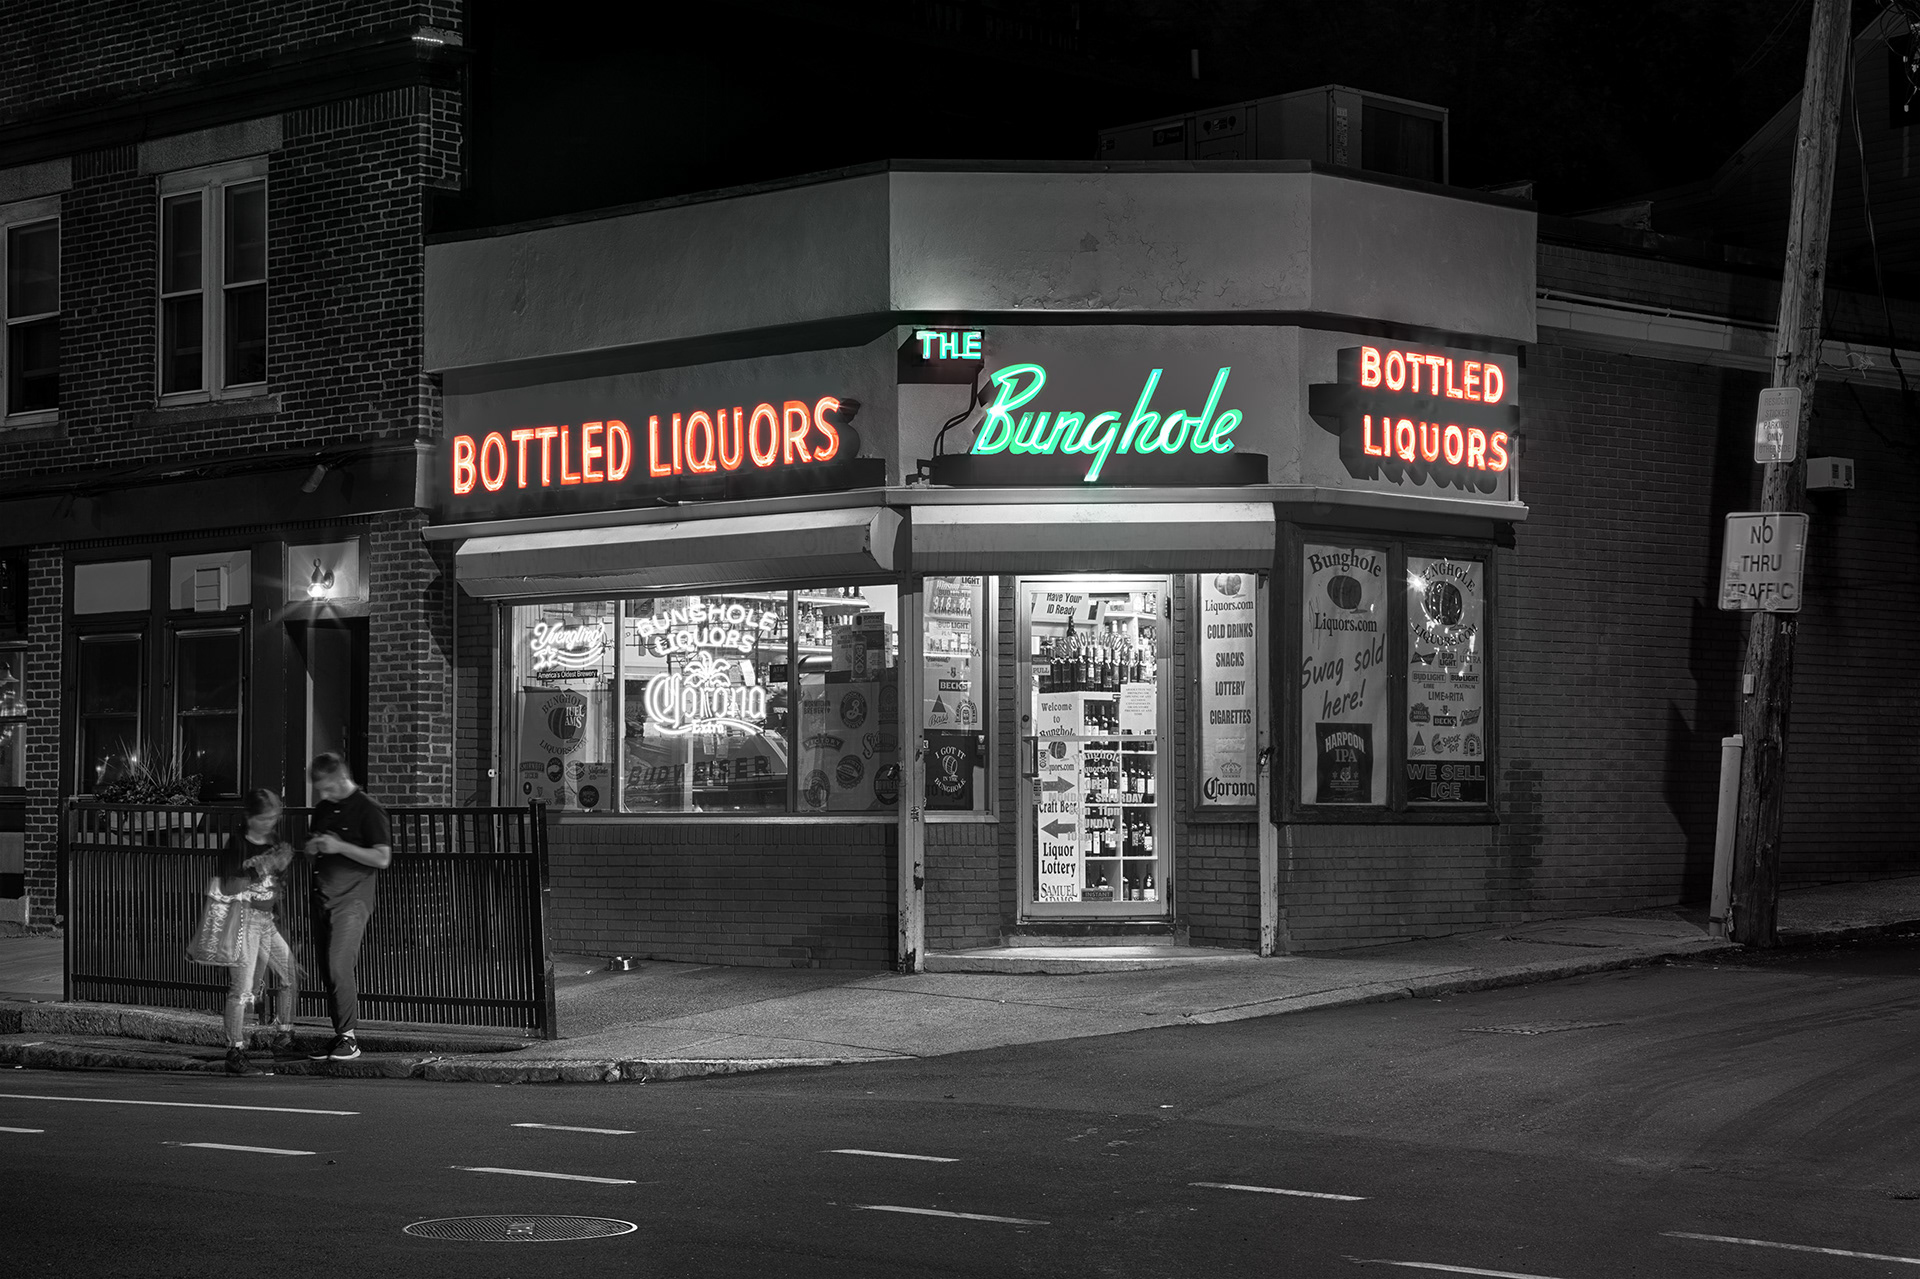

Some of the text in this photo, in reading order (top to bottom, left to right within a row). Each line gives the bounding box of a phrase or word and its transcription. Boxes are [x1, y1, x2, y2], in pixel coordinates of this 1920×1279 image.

[916, 330, 981, 359] THE
[1361, 346, 1504, 403] BOTTLED
[1764, 397, 1793, 406] RESIDENT
[1764, 409, 1790, 417] STICKER
[971, 364, 1243, 481] Bunghole
[1763, 421, 1790, 429] PARKING
[1363, 414, 1509, 471] LIQUORS
[1767, 433, 1784, 441] ONLY
[453, 396, 840, 495] BOTTLED LIQUORS
[1759, 445, 1776, 453] OTHER
[1750, 525, 1773, 544] NO
[1307, 548, 1381, 577] Bunghole
[1740, 555, 1782, 572] THRU
[1421, 562, 1475, 592] UNGHOLE
[1047, 592, 1082, 603] Have Your
[1727, 582, 1795, 600] TRAFFIC
[1047, 603, 1077, 617] ID Ready
[1205, 600, 1254, 615] Liquors.com
[1207, 623, 1254, 639] COLD DRINKS
[1314, 612, 1377, 636] Liquors.com
[531, 621, 604, 651] Yuengling
[655, 627, 755, 653] LIQUORS
[1216, 652, 1245, 667] SNACKS
[1302, 633, 1385, 690] Swag sold
[1216, 681, 1246, 696] LOTTERY
[645, 672, 767, 730] Corona
[1041, 702, 1072, 712] Welcome
[1322, 678, 1366, 720] here!
[1053, 716, 1061, 724] to
[1210, 709, 1252, 725] CIGARETTES
[1325, 731, 1365, 754] HARPOON
[940, 746, 956, 756] GOT
[957, 750, 966, 760] IT
[1335, 749, 1357, 762] IPA
[1407, 764, 1485, 780] WE SELL
[1204, 777, 1256, 802] Corona
[1430, 782, 1461, 798] ICE
[1095, 793, 1144, 803] SATURDAY
[1039, 801, 1057, 813] Craft
[1043, 842, 1074, 859] Liquor
[1041, 860, 1076, 877] Lottery
[1041, 883, 1078, 898] SAMUEL
